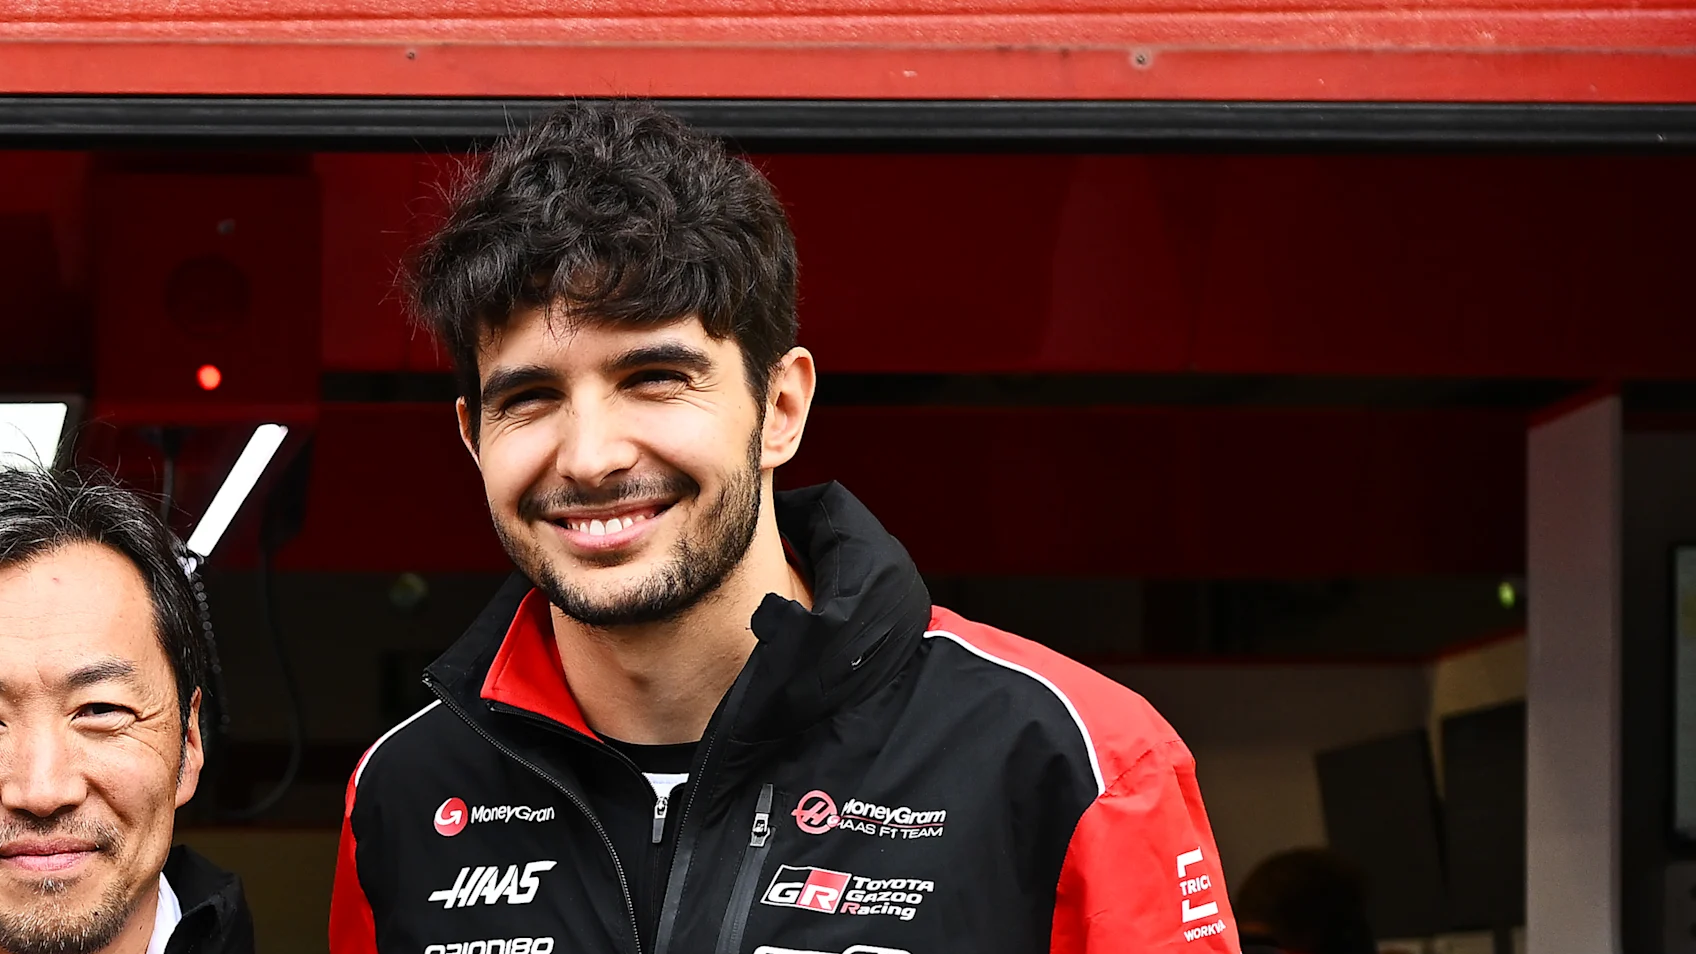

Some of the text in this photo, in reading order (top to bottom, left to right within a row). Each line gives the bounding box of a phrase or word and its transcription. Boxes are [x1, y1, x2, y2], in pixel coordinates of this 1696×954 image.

[879, 828, 896, 839] F1
[901, 827, 944, 839] TEAM
[428, 860, 557, 909] HAAS
[852, 876, 934, 893] TOYOTA
[768, 882, 839, 911] GR
[845, 890, 923, 905] GAZOO
[840, 902, 916, 921] Racing
